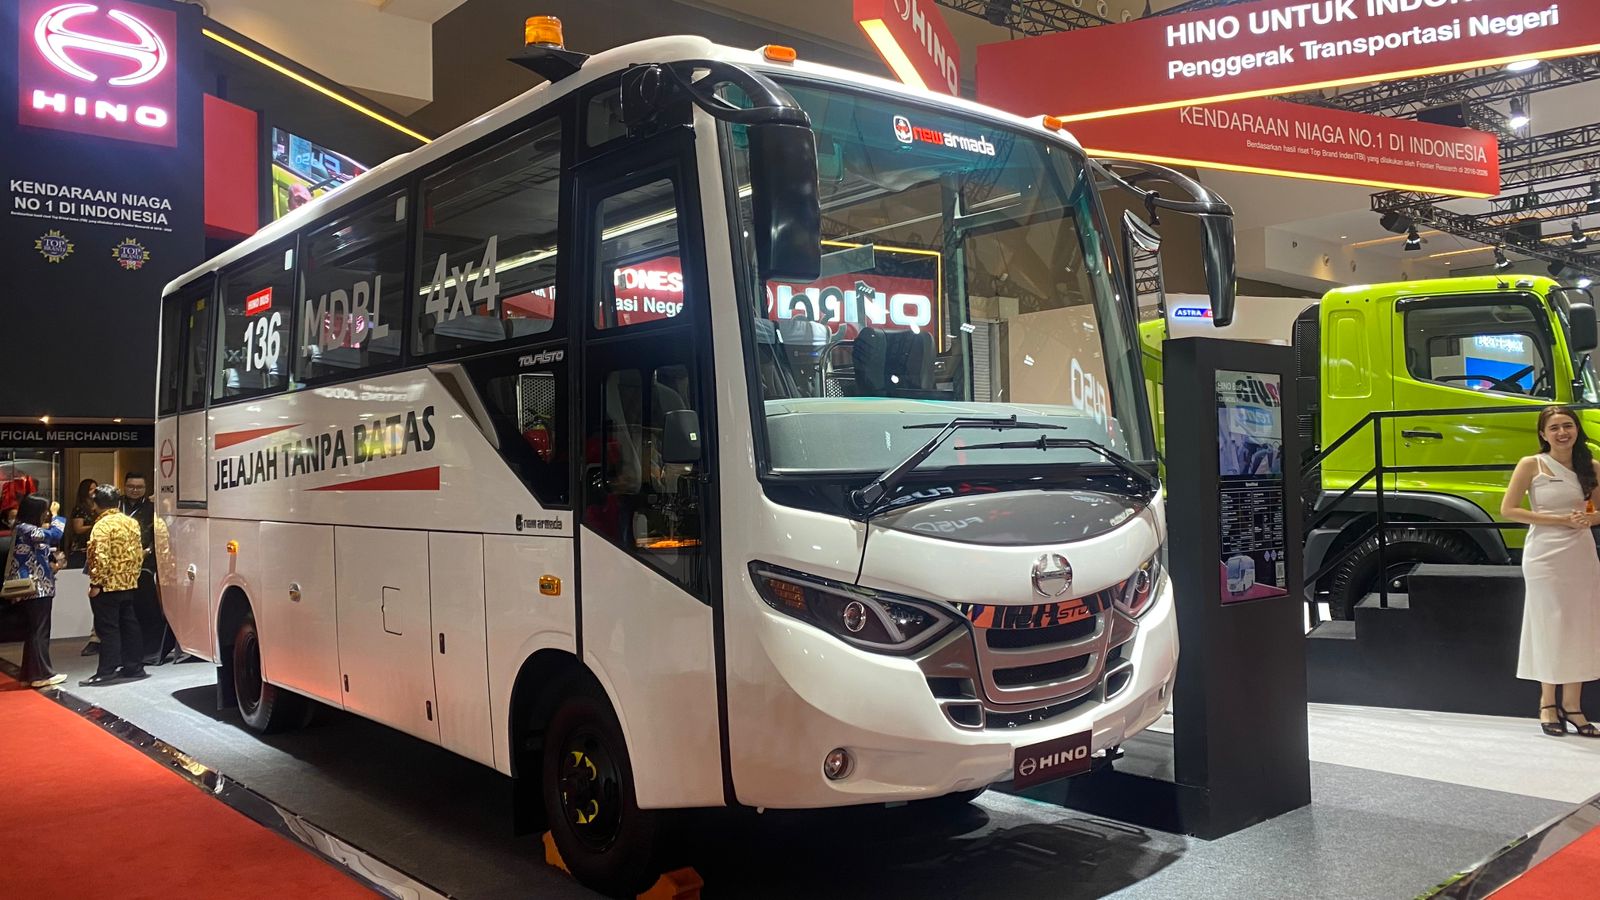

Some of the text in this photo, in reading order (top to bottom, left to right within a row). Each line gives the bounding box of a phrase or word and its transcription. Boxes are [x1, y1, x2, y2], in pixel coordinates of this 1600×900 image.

[1167, 15, 1240, 47] HINO
[1249, 0, 1359, 35] UNTUK
[1168, 5, 1559, 79] Penggerak Transportasi Negeri
[912, 0, 958, 97] HINO
[32, 89, 168, 128] HINO
[1179, 105, 1487, 163] KENDARAAN NIAGA NO.1 DI INDONESIA
[1246, 139, 1282, 152] Berdasarkan
[1283, 144, 1296, 153] hasil
[1297, 146, 1309, 155] riset
[1310, 147, 1321, 157] Top
[1322, 149, 1338, 158] Brand
[1367, 155, 1379, 164] yang
[10, 179, 172, 211] KENDARAAN NIAGA
[15, 197, 40, 211] NO
[45, 200, 53, 212] 1
[59, 202, 75, 215] DI
[80, 204, 168, 225] INDONESIA
[44, 239, 64, 248] TOP
[121, 246, 141, 255] TOP
[425, 234, 500, 323] 4x4
[303, 274, 389, 357] MDBL
[1177, 309, 1202, 317] ASTRA
[244, 311, 282, 372] 136
[46, 431, 138, 441] MERCHANDISE
[214, 405, 436, 491] JELAJAH TANPA BATAS
[1039, 745, 1087, 770] HINO
